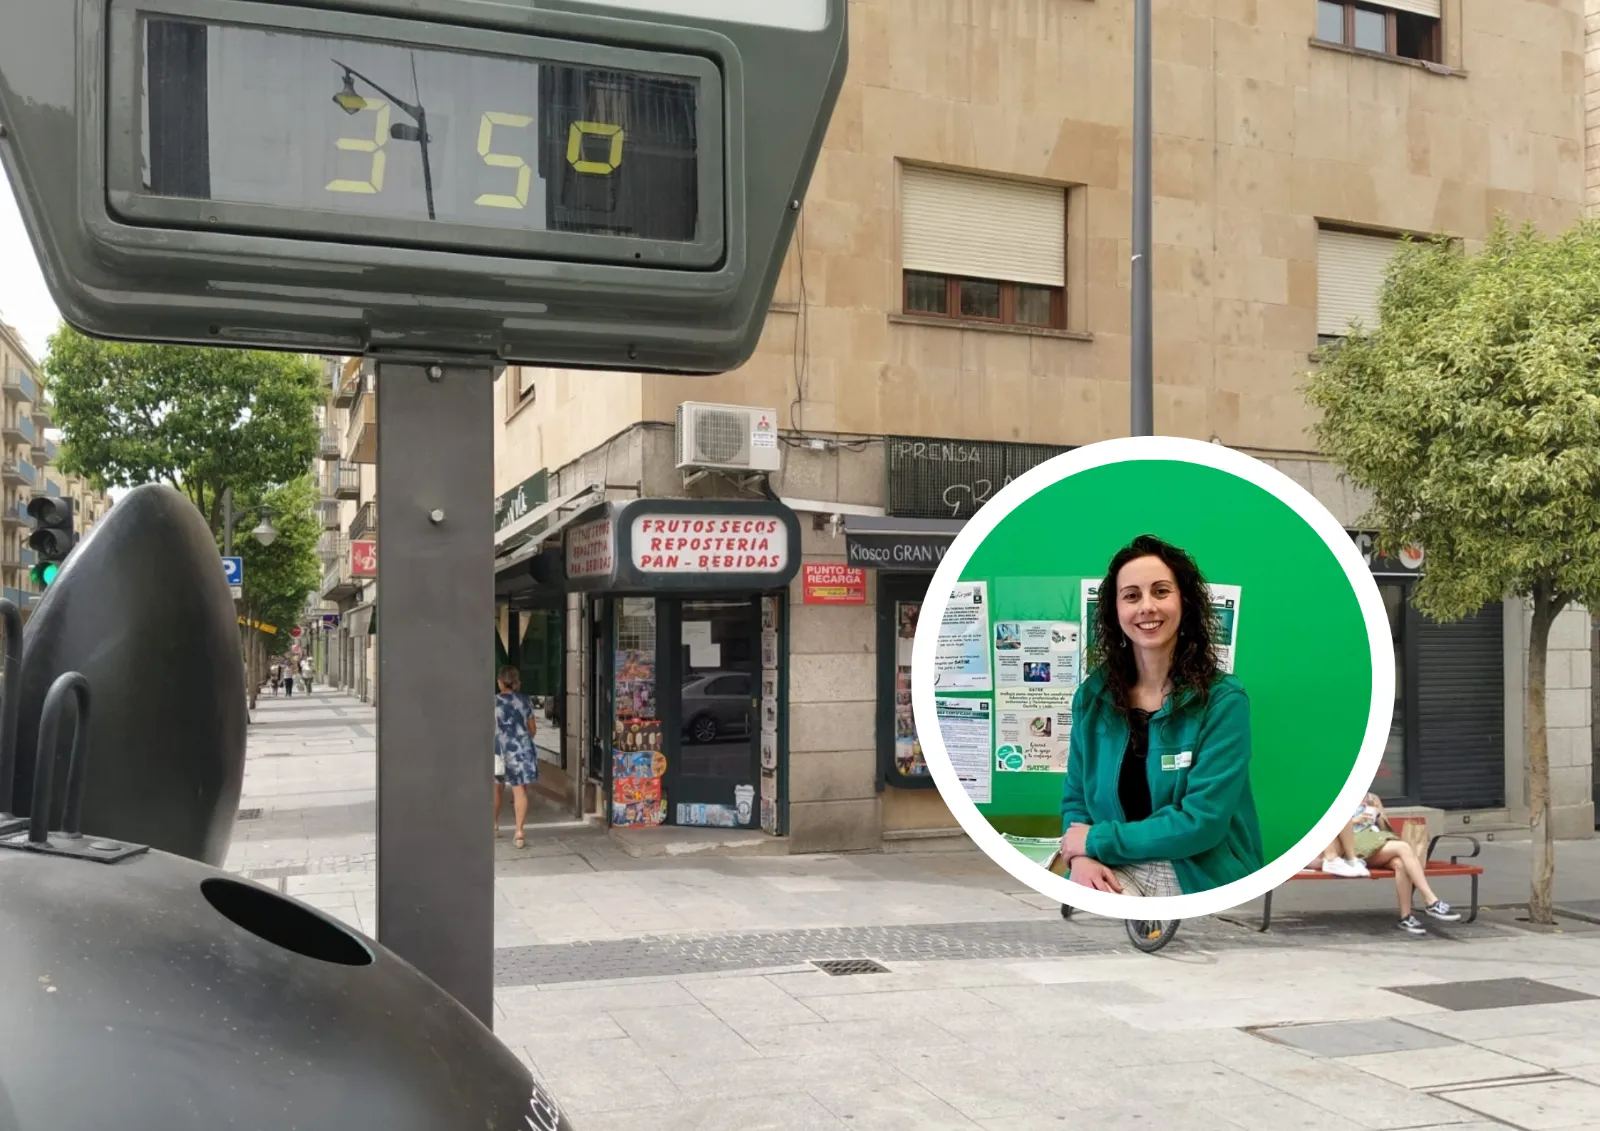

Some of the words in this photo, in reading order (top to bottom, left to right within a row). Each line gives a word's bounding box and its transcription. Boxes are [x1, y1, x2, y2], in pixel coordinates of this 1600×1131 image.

[899, 441, 980, 462] PRENSA
[642, 520, 716, 533] FRUTOS
[720, 520, 777, 533] SECOS
[650, 537, 769, 551] REPOSTERIA
[850, 543, 890, 561] Kiosco
[893, 545, 932, 562] GRAN
[641, 556, 680, 568] PAN
[698, 555, 780, 568] BEBIDAS
[806, 565, 845, 575] PUNTO
[847, 567, 862, 575] DE
[807, 574, 861, 584] RECARGA
